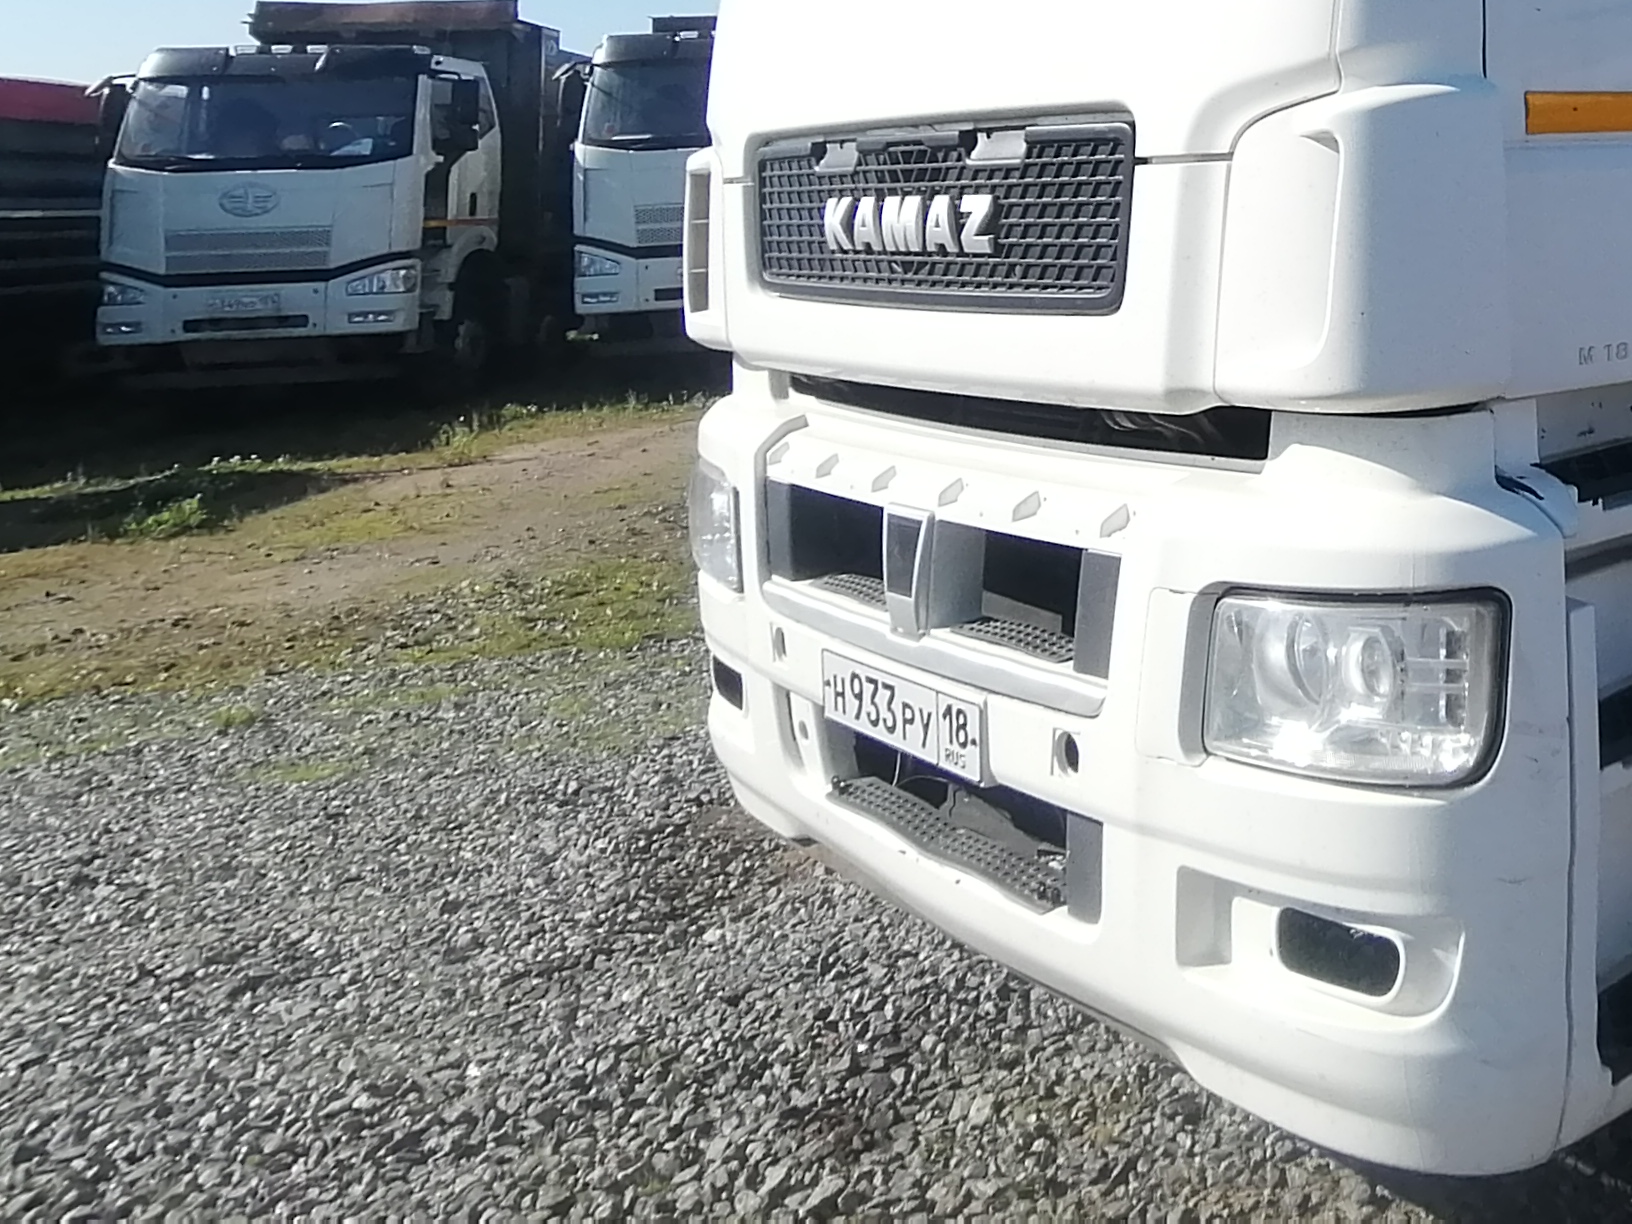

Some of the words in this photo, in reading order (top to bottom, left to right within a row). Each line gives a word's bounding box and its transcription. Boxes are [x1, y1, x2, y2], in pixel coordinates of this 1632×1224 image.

[824, 193, 995, 254] KAMAZ
[1578, 345, 1595, 365] M
[942, 703, 969, 749] 18
[944, 747, 967, 770] RUS
